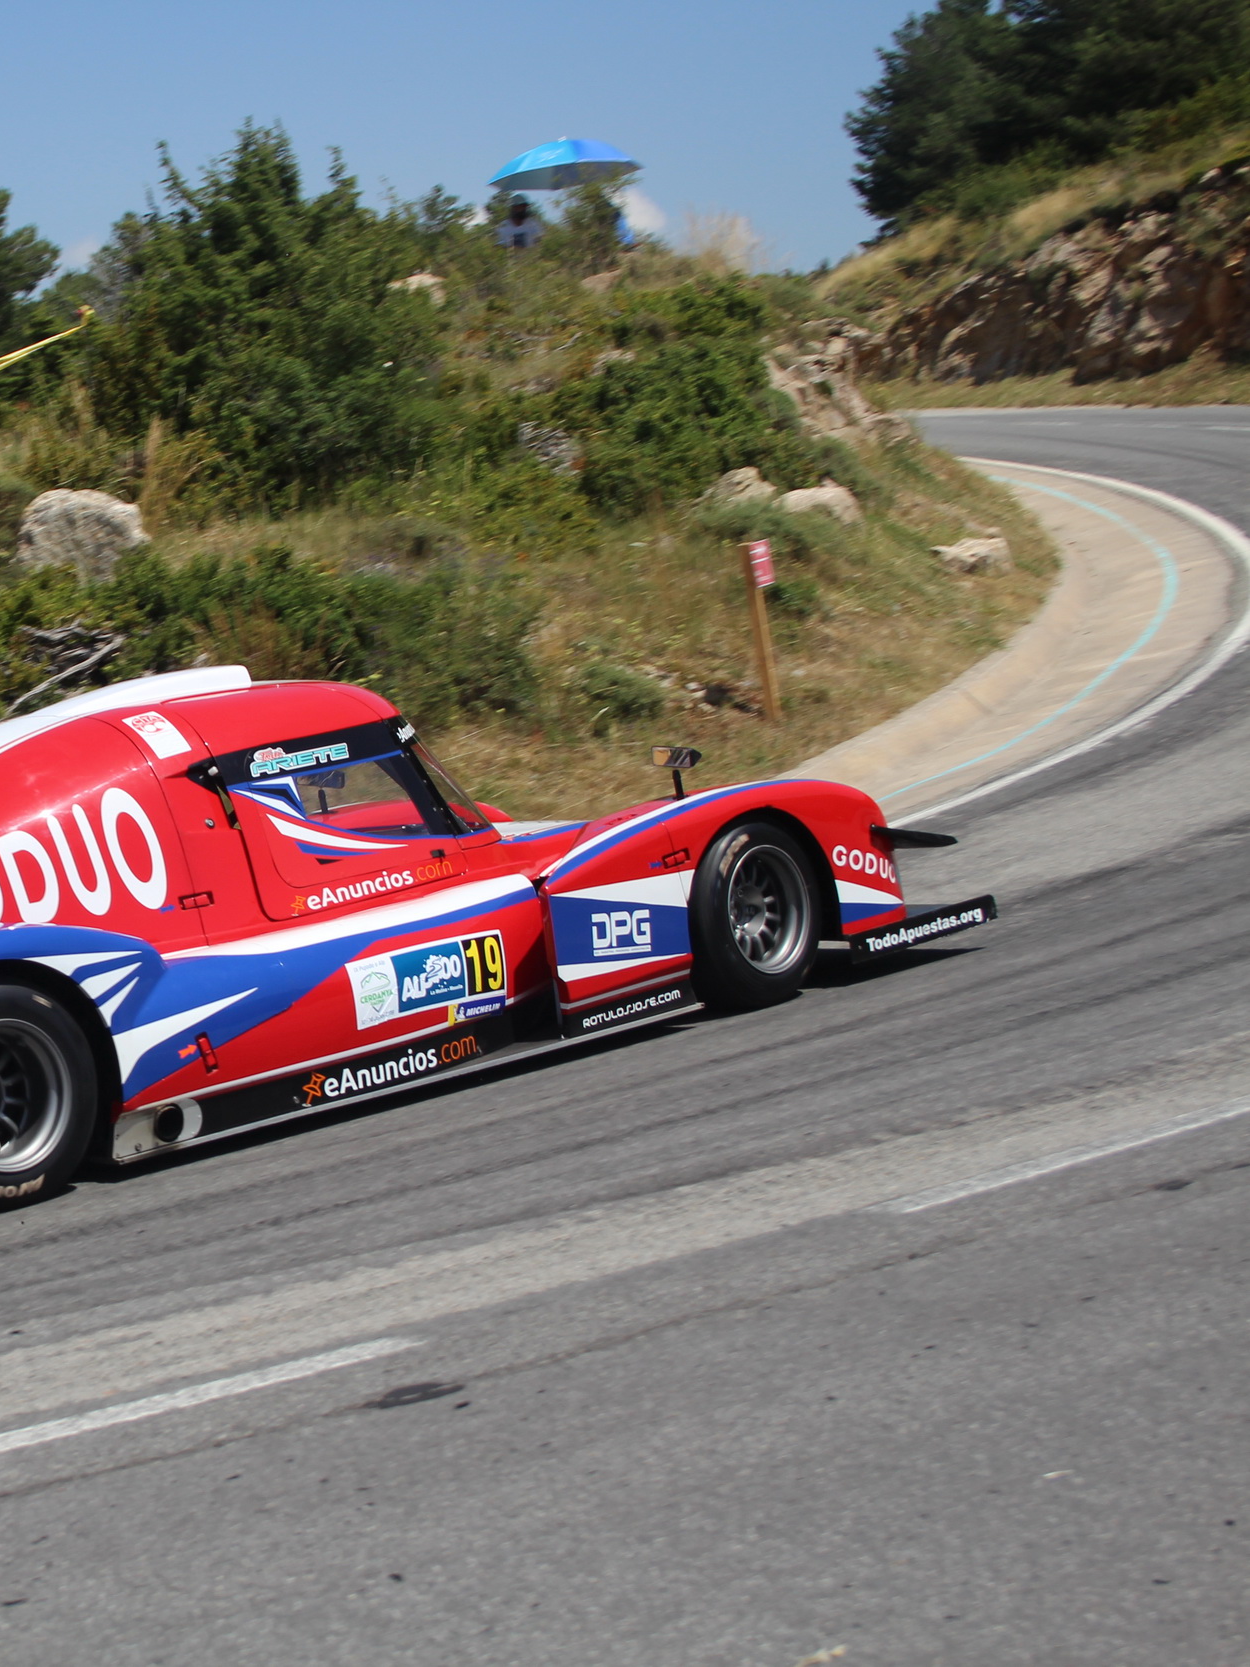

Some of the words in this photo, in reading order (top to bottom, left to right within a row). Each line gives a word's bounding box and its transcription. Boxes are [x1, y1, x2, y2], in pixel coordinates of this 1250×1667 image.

[252, 744, 349, 776] ARIETE
[306, 861, 454, 911] eAnuncios.com
[591, 908, 652, 949] DPG
[866, 907, 983, 952] TodoApuestas.org
[465, 936, 503, 993] 19
[465, 1002, 501, 1018] MICHELIN
[324, 1035, 477, 1098] eAnuncios.com
